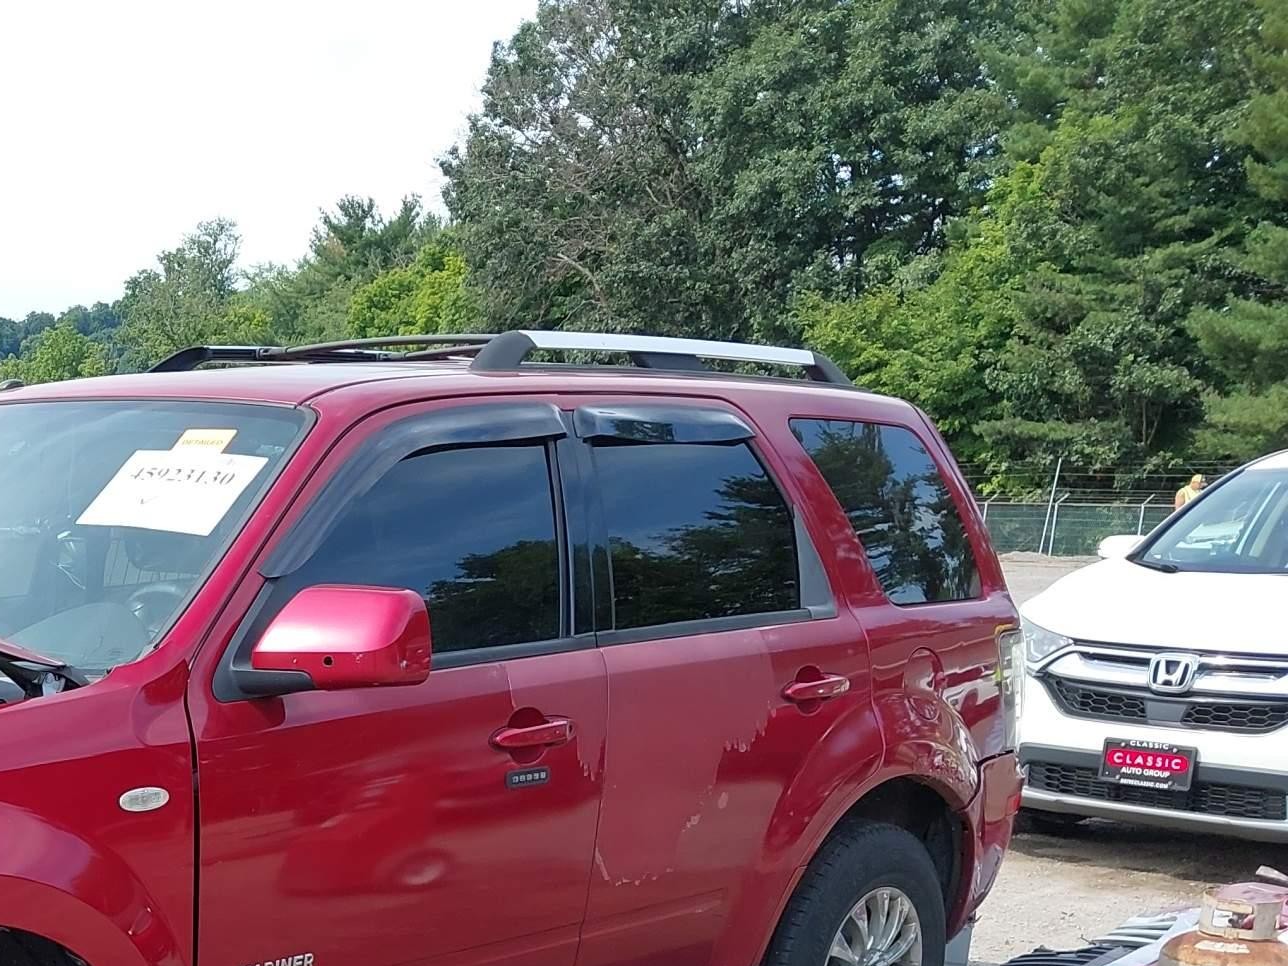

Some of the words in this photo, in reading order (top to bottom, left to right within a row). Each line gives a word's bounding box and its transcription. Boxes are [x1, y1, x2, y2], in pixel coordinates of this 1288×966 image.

[130, 466, 236, 486] 45923130
[1129, 740, 1170, 750] CLASSIC
[1113, 752, 1182, 770] CLASSIC
[1120, 766, 1143, 775] AUTO
[1143, 768, 1171, 778] GROUP
